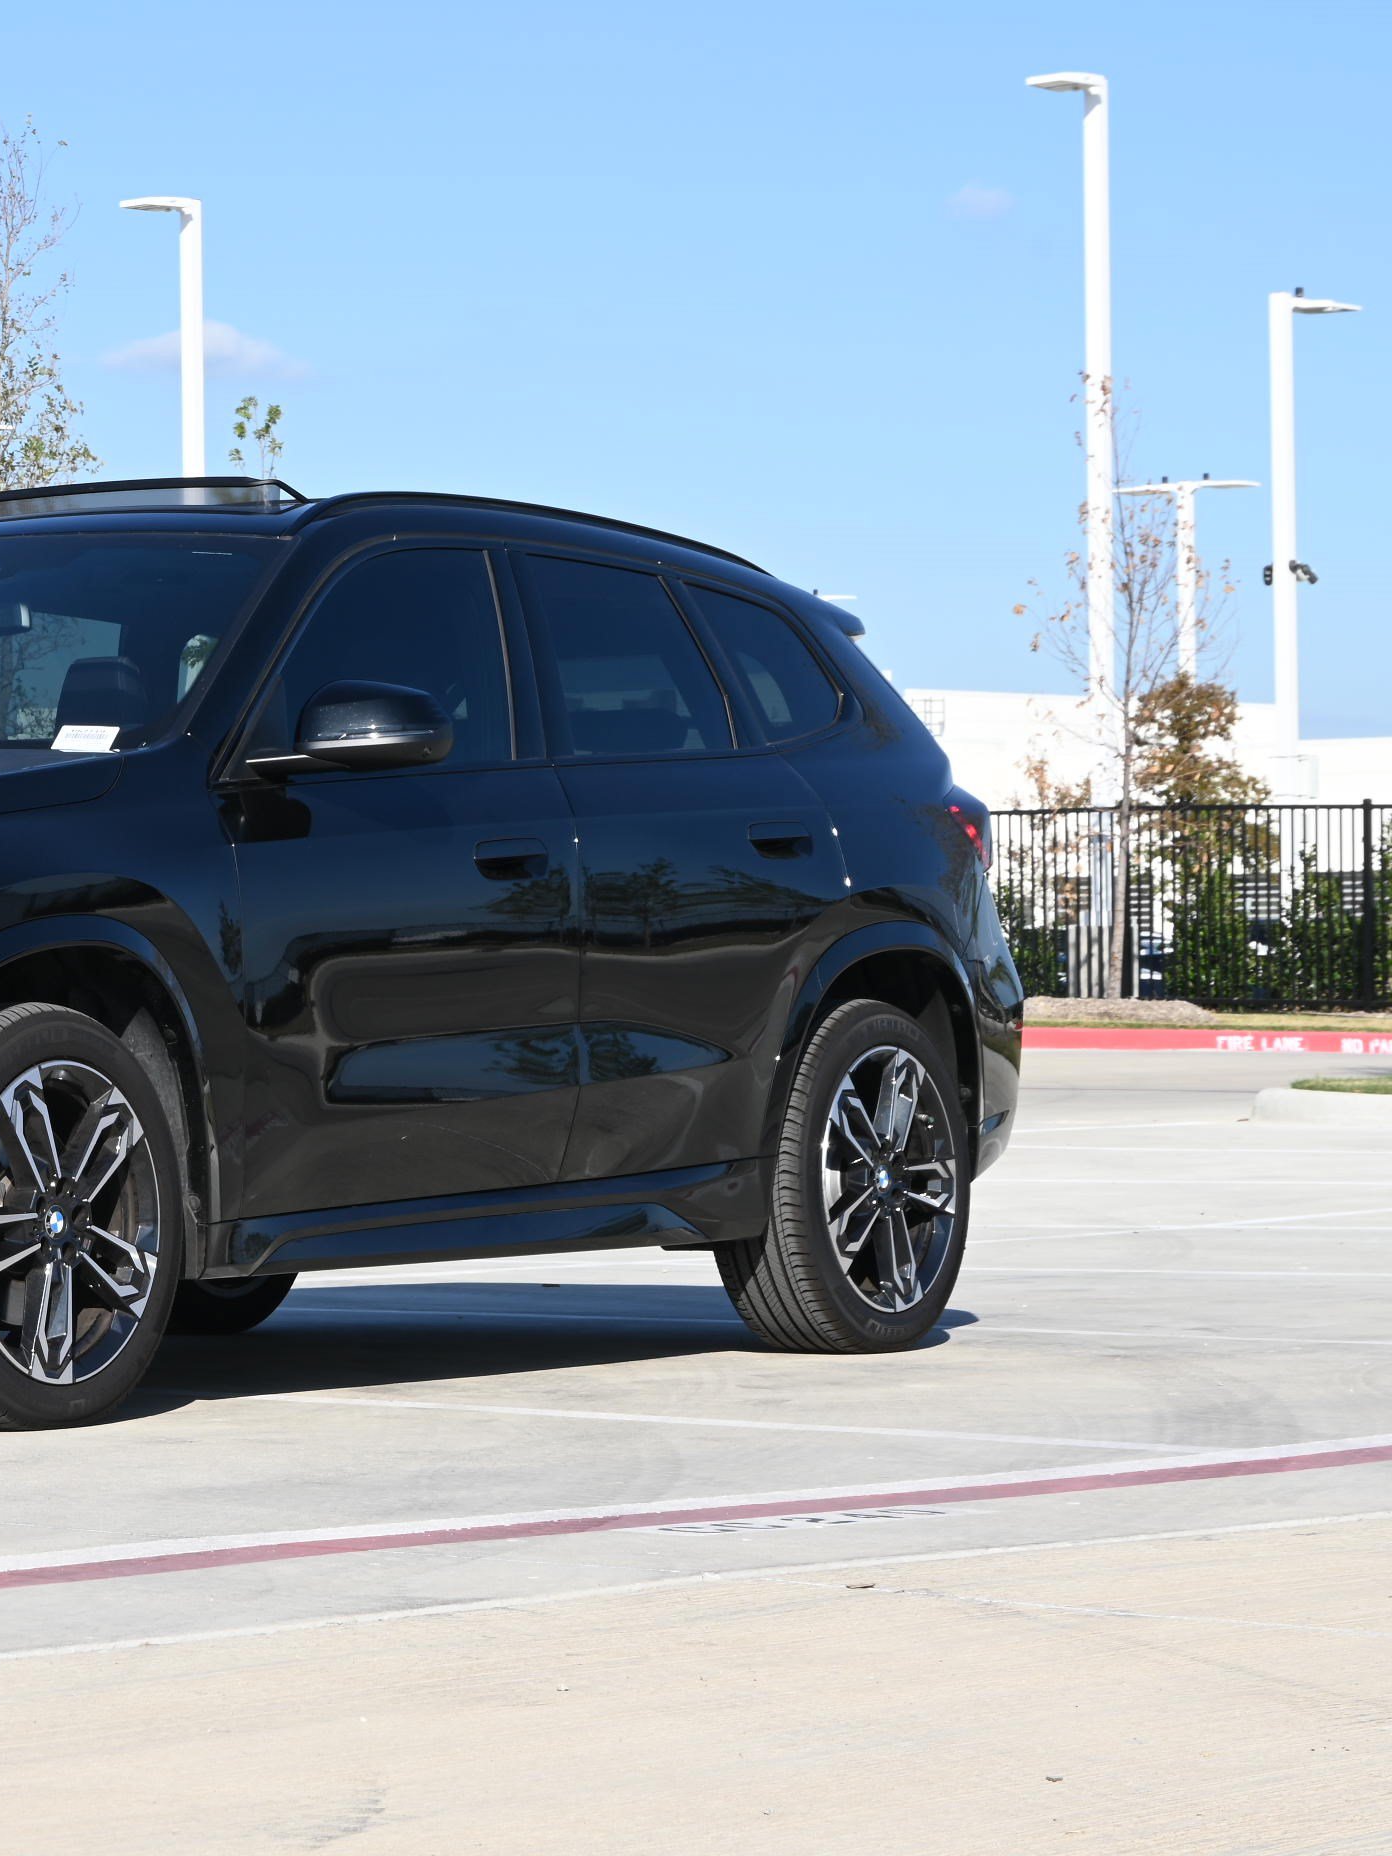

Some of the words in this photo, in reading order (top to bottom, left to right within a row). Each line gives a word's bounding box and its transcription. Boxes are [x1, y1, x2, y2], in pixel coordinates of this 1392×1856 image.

[1216, 1035, 1256, 1051] FIRE
[1261, 1036, 1305, 1052] LANE
[1341, 1038, 1363, 1053] NO
